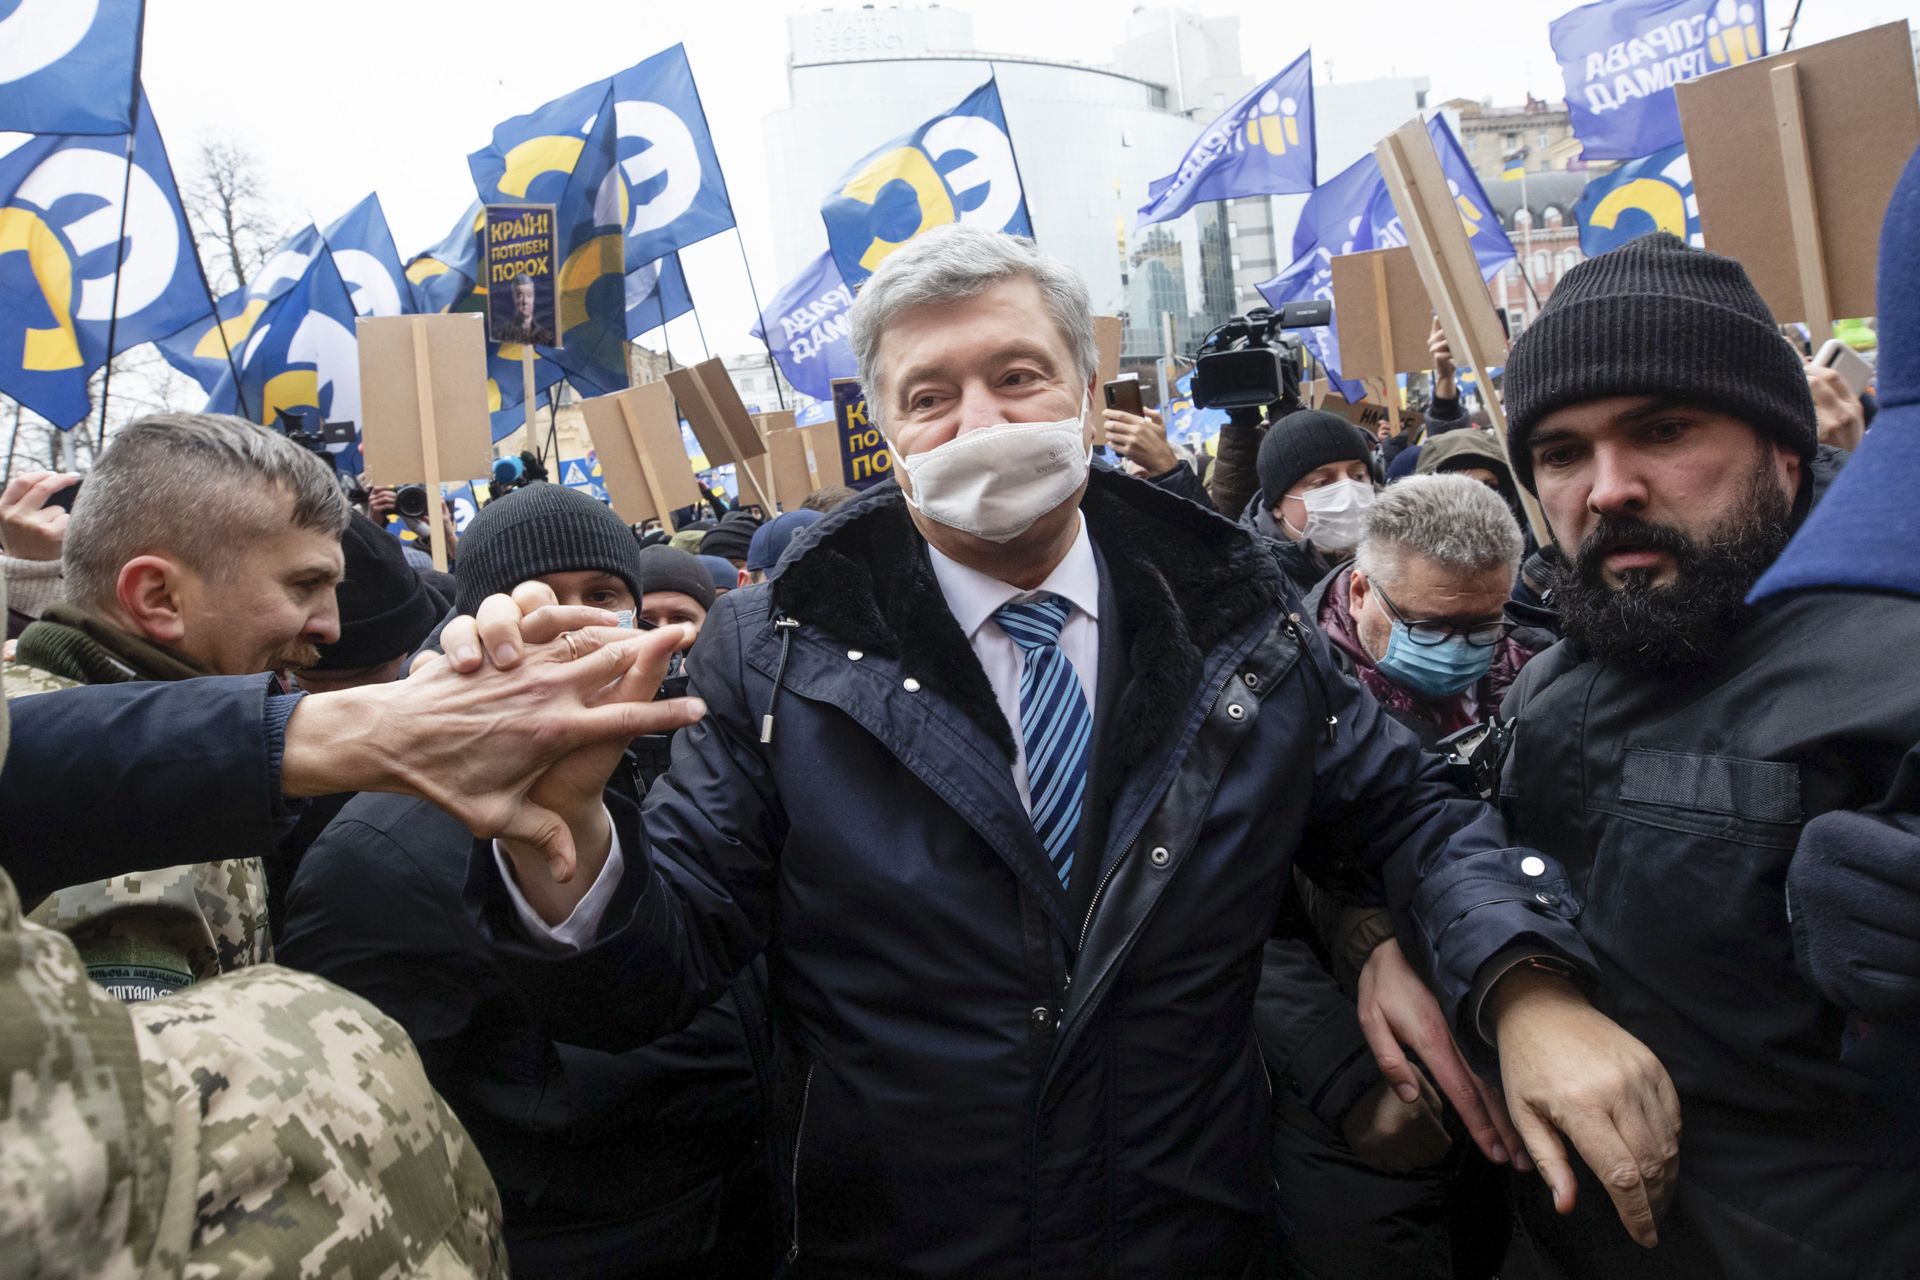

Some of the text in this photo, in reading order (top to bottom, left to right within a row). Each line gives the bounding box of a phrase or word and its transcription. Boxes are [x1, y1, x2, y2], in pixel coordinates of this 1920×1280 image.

[491, 213, 549, 243] КРАЇНІ
[491, 239, 549, 261] ПОТРІБЕН
[492, 256, 549, 282] ПОРОХ
[87, 968, 130, 979] ОЛЬОВА
